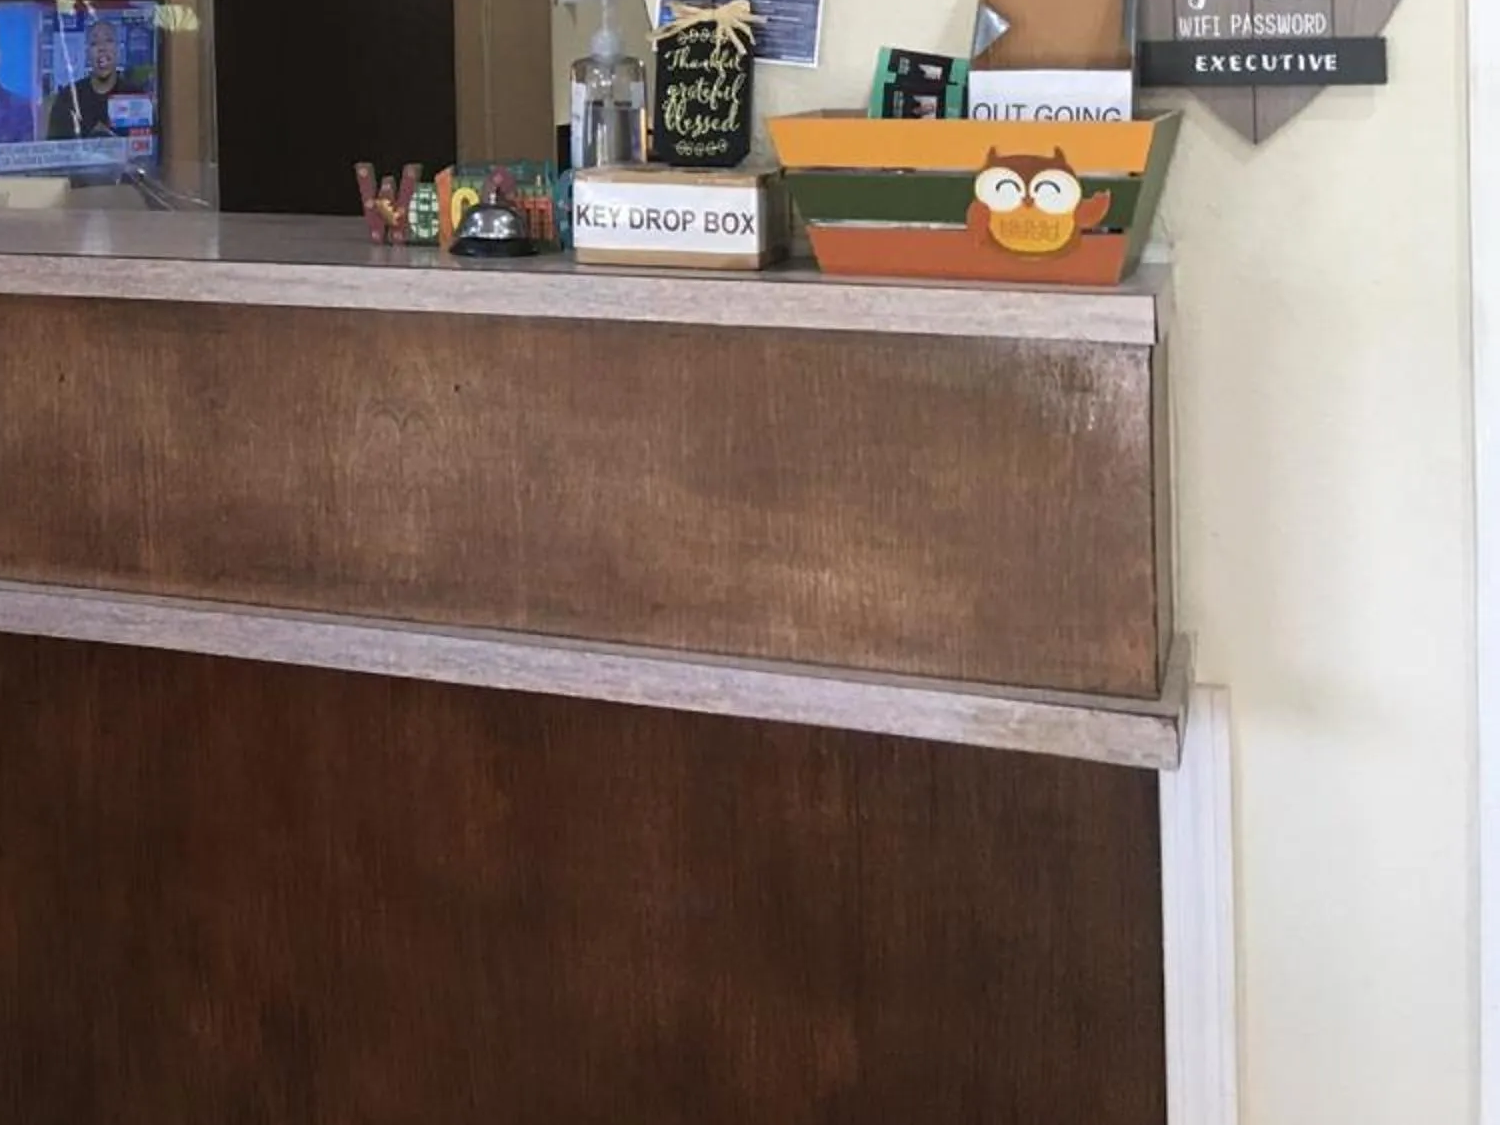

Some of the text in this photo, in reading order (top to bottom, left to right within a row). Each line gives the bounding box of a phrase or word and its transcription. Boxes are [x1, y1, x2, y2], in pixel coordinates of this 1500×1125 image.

[1179, 13, 1327, 37] WIFI PASSWORD
[1195, 54, 1338, 72] EXECUTIVE
[972, 102, 1122, 121] OUT GOING
[576, 204, 755, 235] KEY DROP BOX
